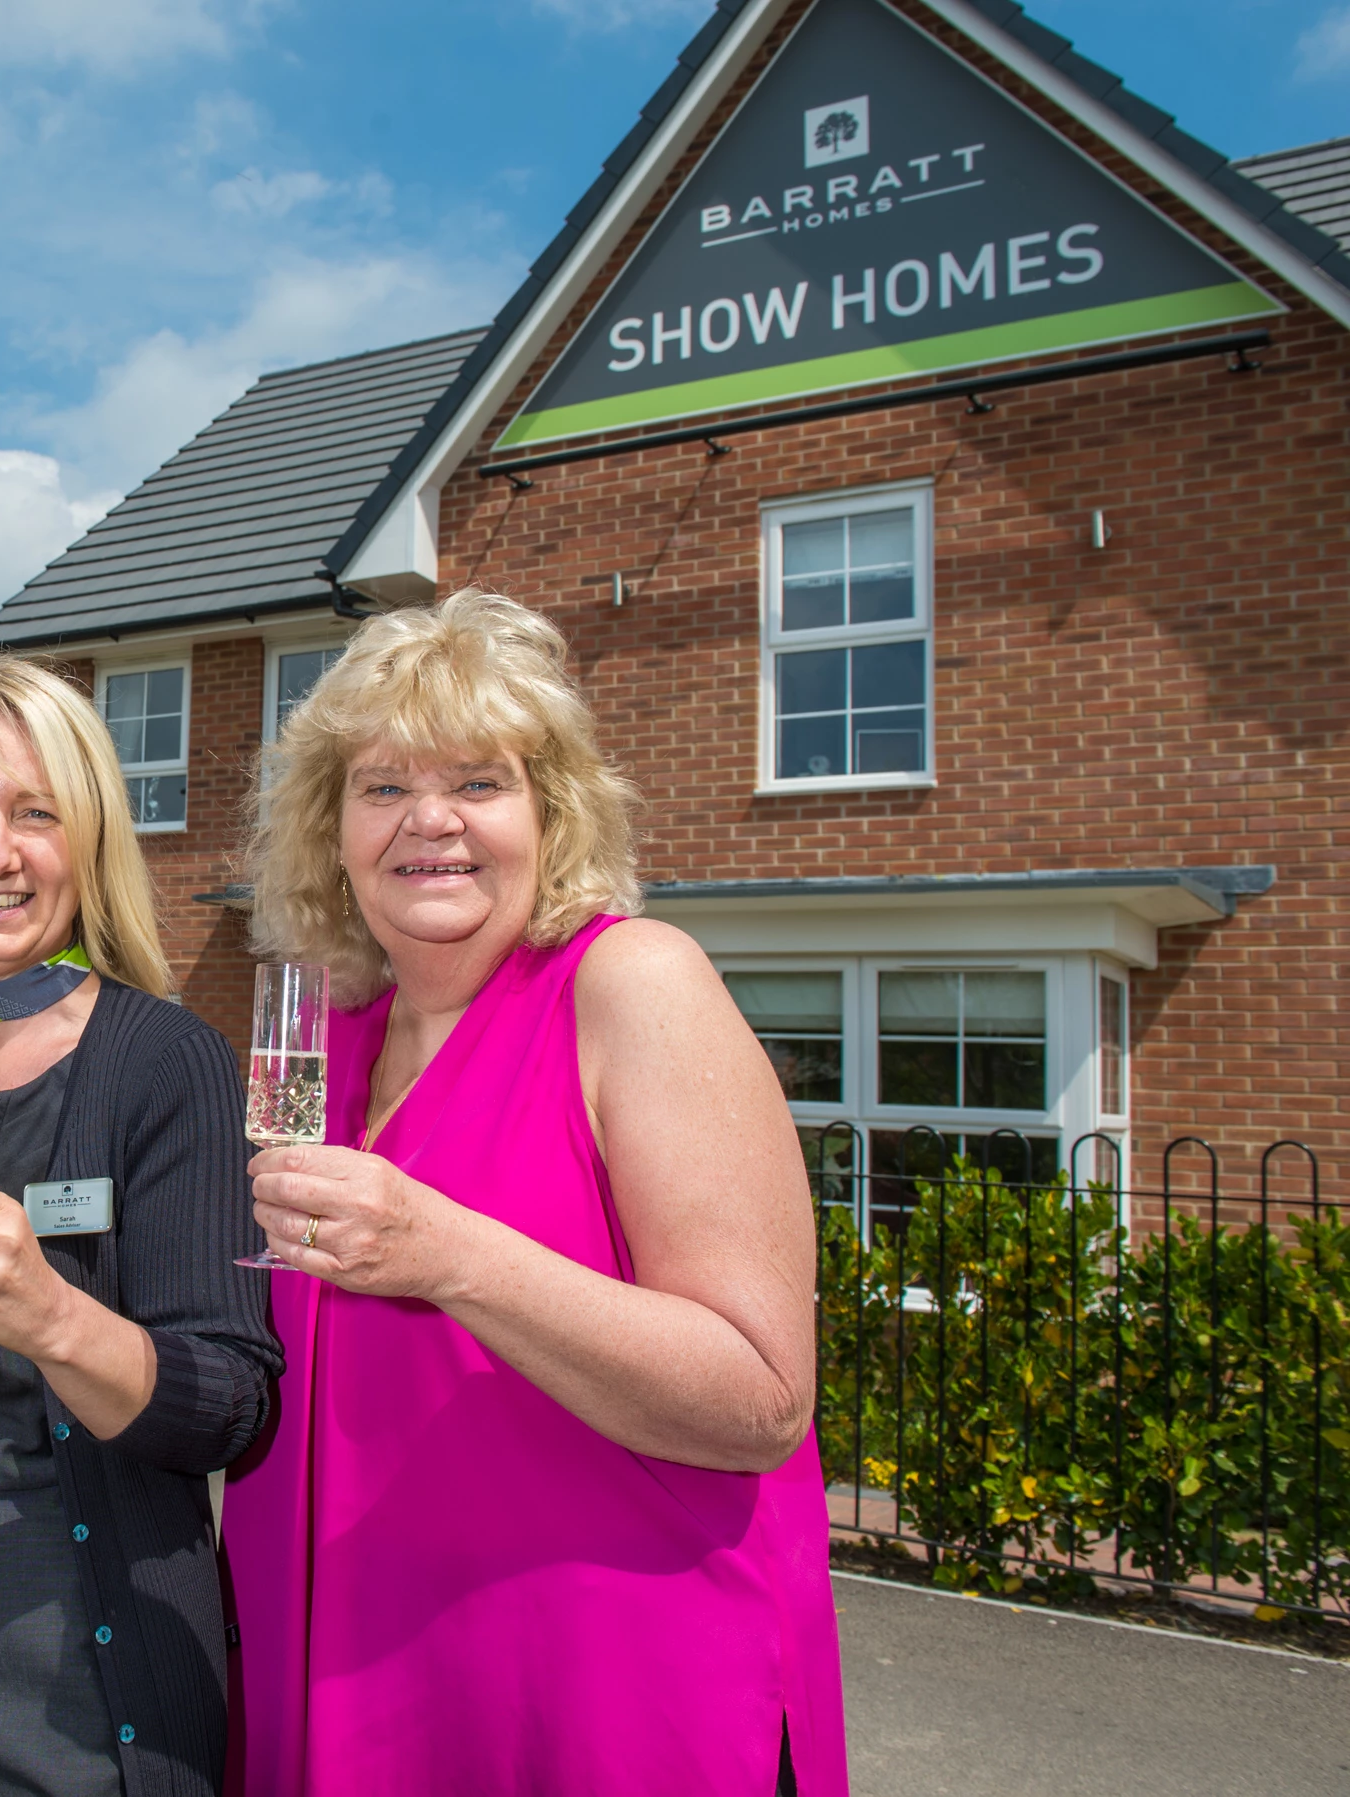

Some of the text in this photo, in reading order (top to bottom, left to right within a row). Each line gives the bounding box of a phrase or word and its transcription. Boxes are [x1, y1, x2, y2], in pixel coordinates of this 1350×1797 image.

[701, 143, 985, 232] BARRATT
[782, 197, 893, 234] HOMES
[607, 222, 1105, 373] SHOW HOMES
[43, 1196, 91, 1205] BARRATT
